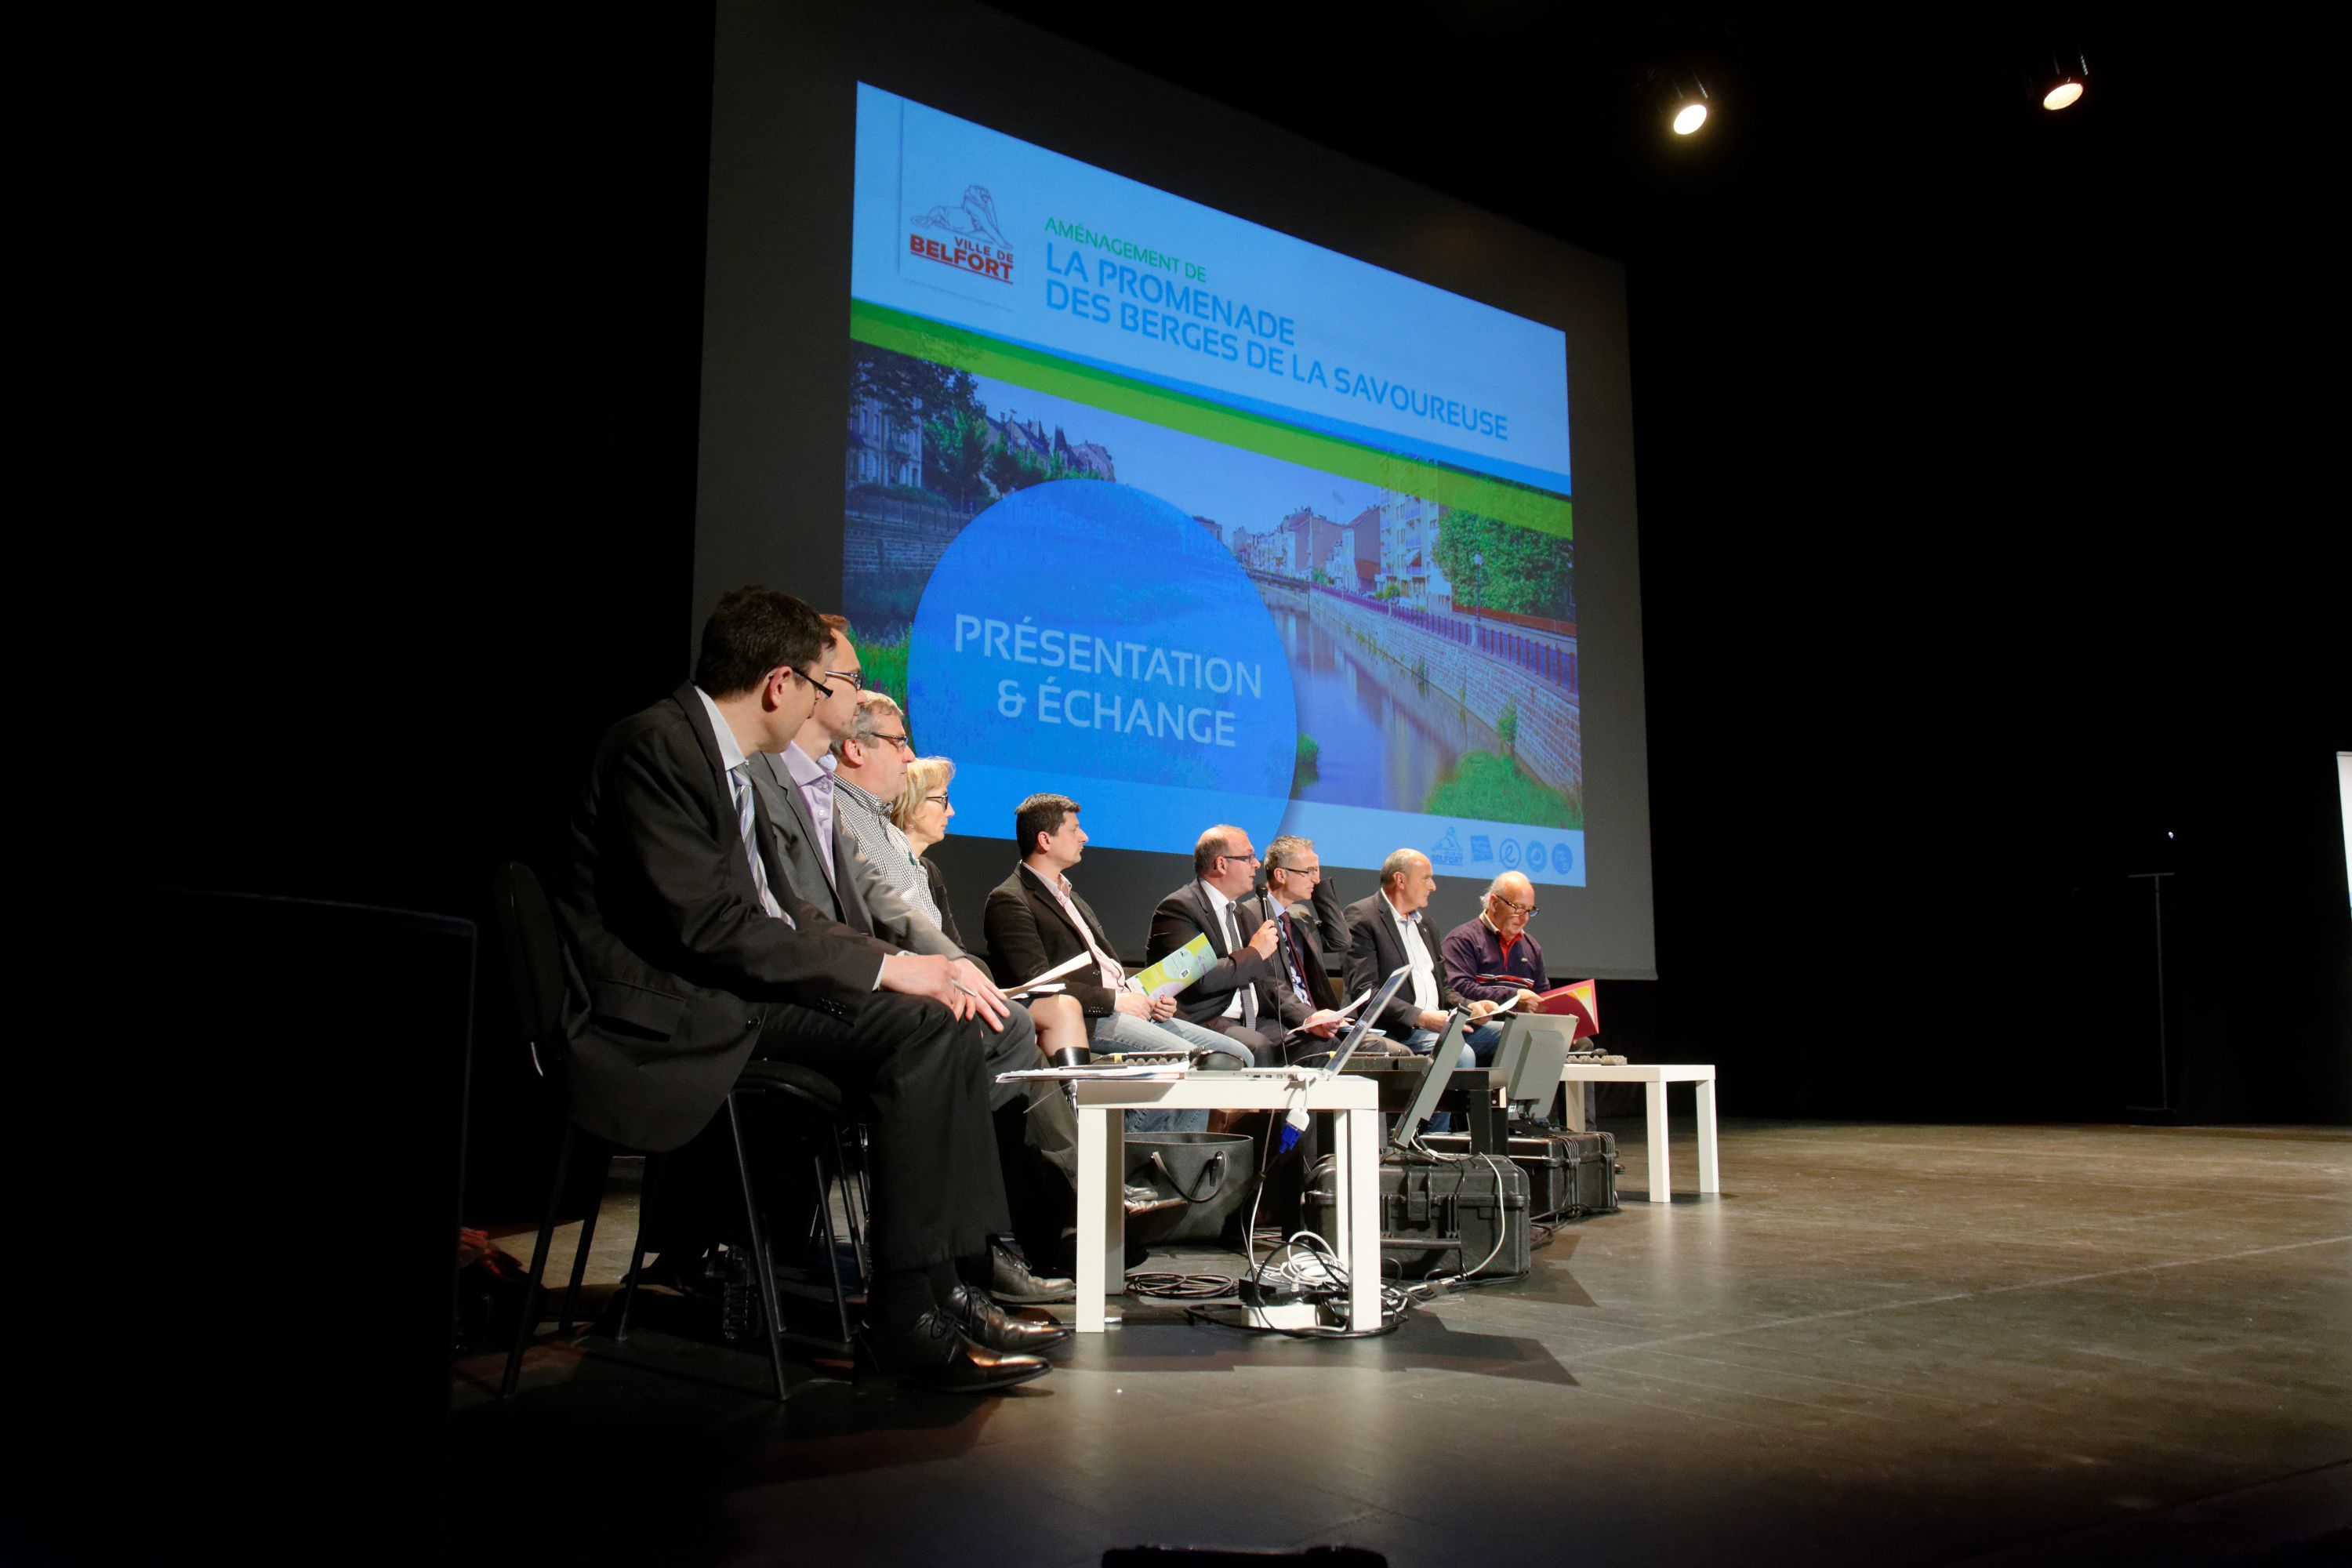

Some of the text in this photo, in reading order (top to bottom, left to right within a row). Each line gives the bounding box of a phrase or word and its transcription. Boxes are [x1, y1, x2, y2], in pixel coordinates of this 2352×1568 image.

[909, 234, 1014, 280] BELFORT
[954, 235, 1014, 263] VILLE DE
[1045, 217, 1207, 283] AMÉNAGEMENT DE
[1047, 242, 1295, 346] LA PROMENADE
[1046, 279, 1508, 441] DES BERGES DE LA SAVOUREUSE
[954, 614, 1261, 699] PRÉSENTATION
[997, 677, 1236, 747] & ÉCHANGE
